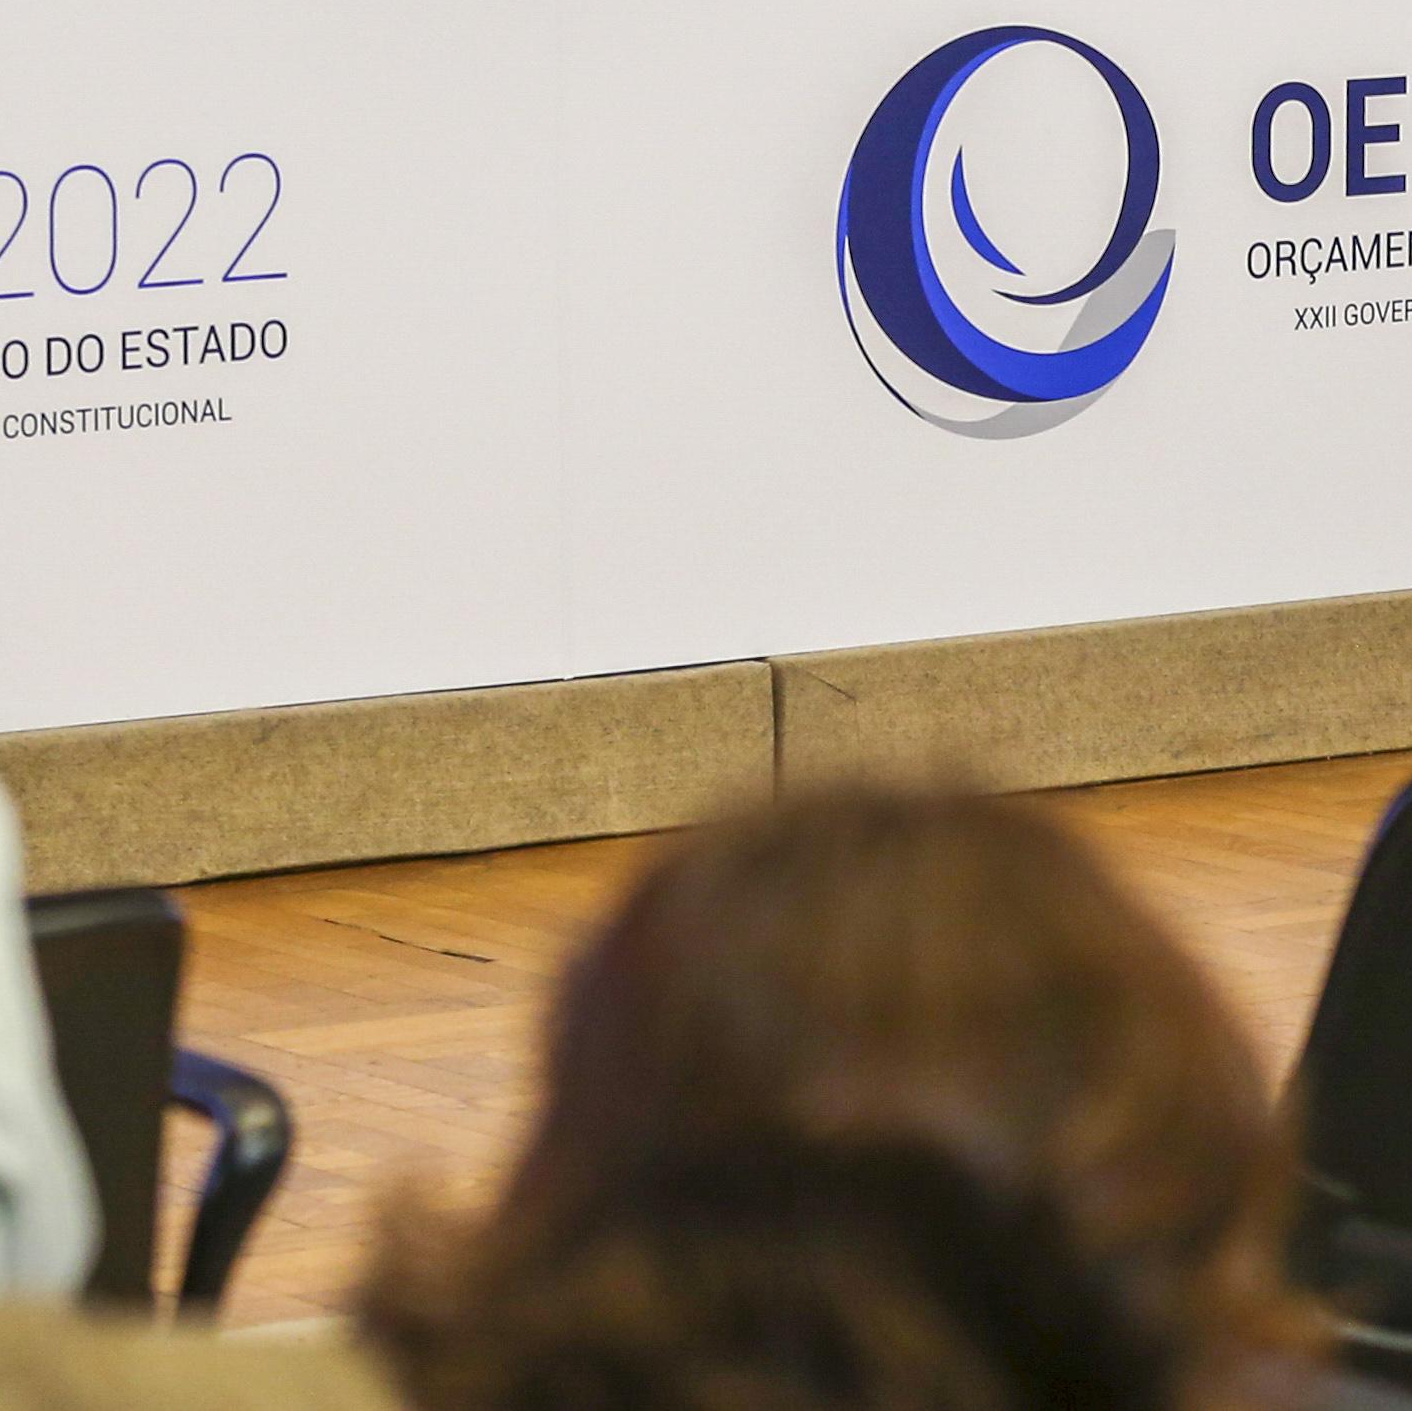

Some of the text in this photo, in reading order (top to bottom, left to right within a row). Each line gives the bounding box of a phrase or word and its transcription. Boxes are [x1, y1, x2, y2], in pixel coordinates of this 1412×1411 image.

[1294, 304, 1337, 330] XXII
[46, 334, 104, 376] DO
[122, 320, 287, 370] ESTADO
[3, 398, 233, 439] CONSTITUCIONAL
